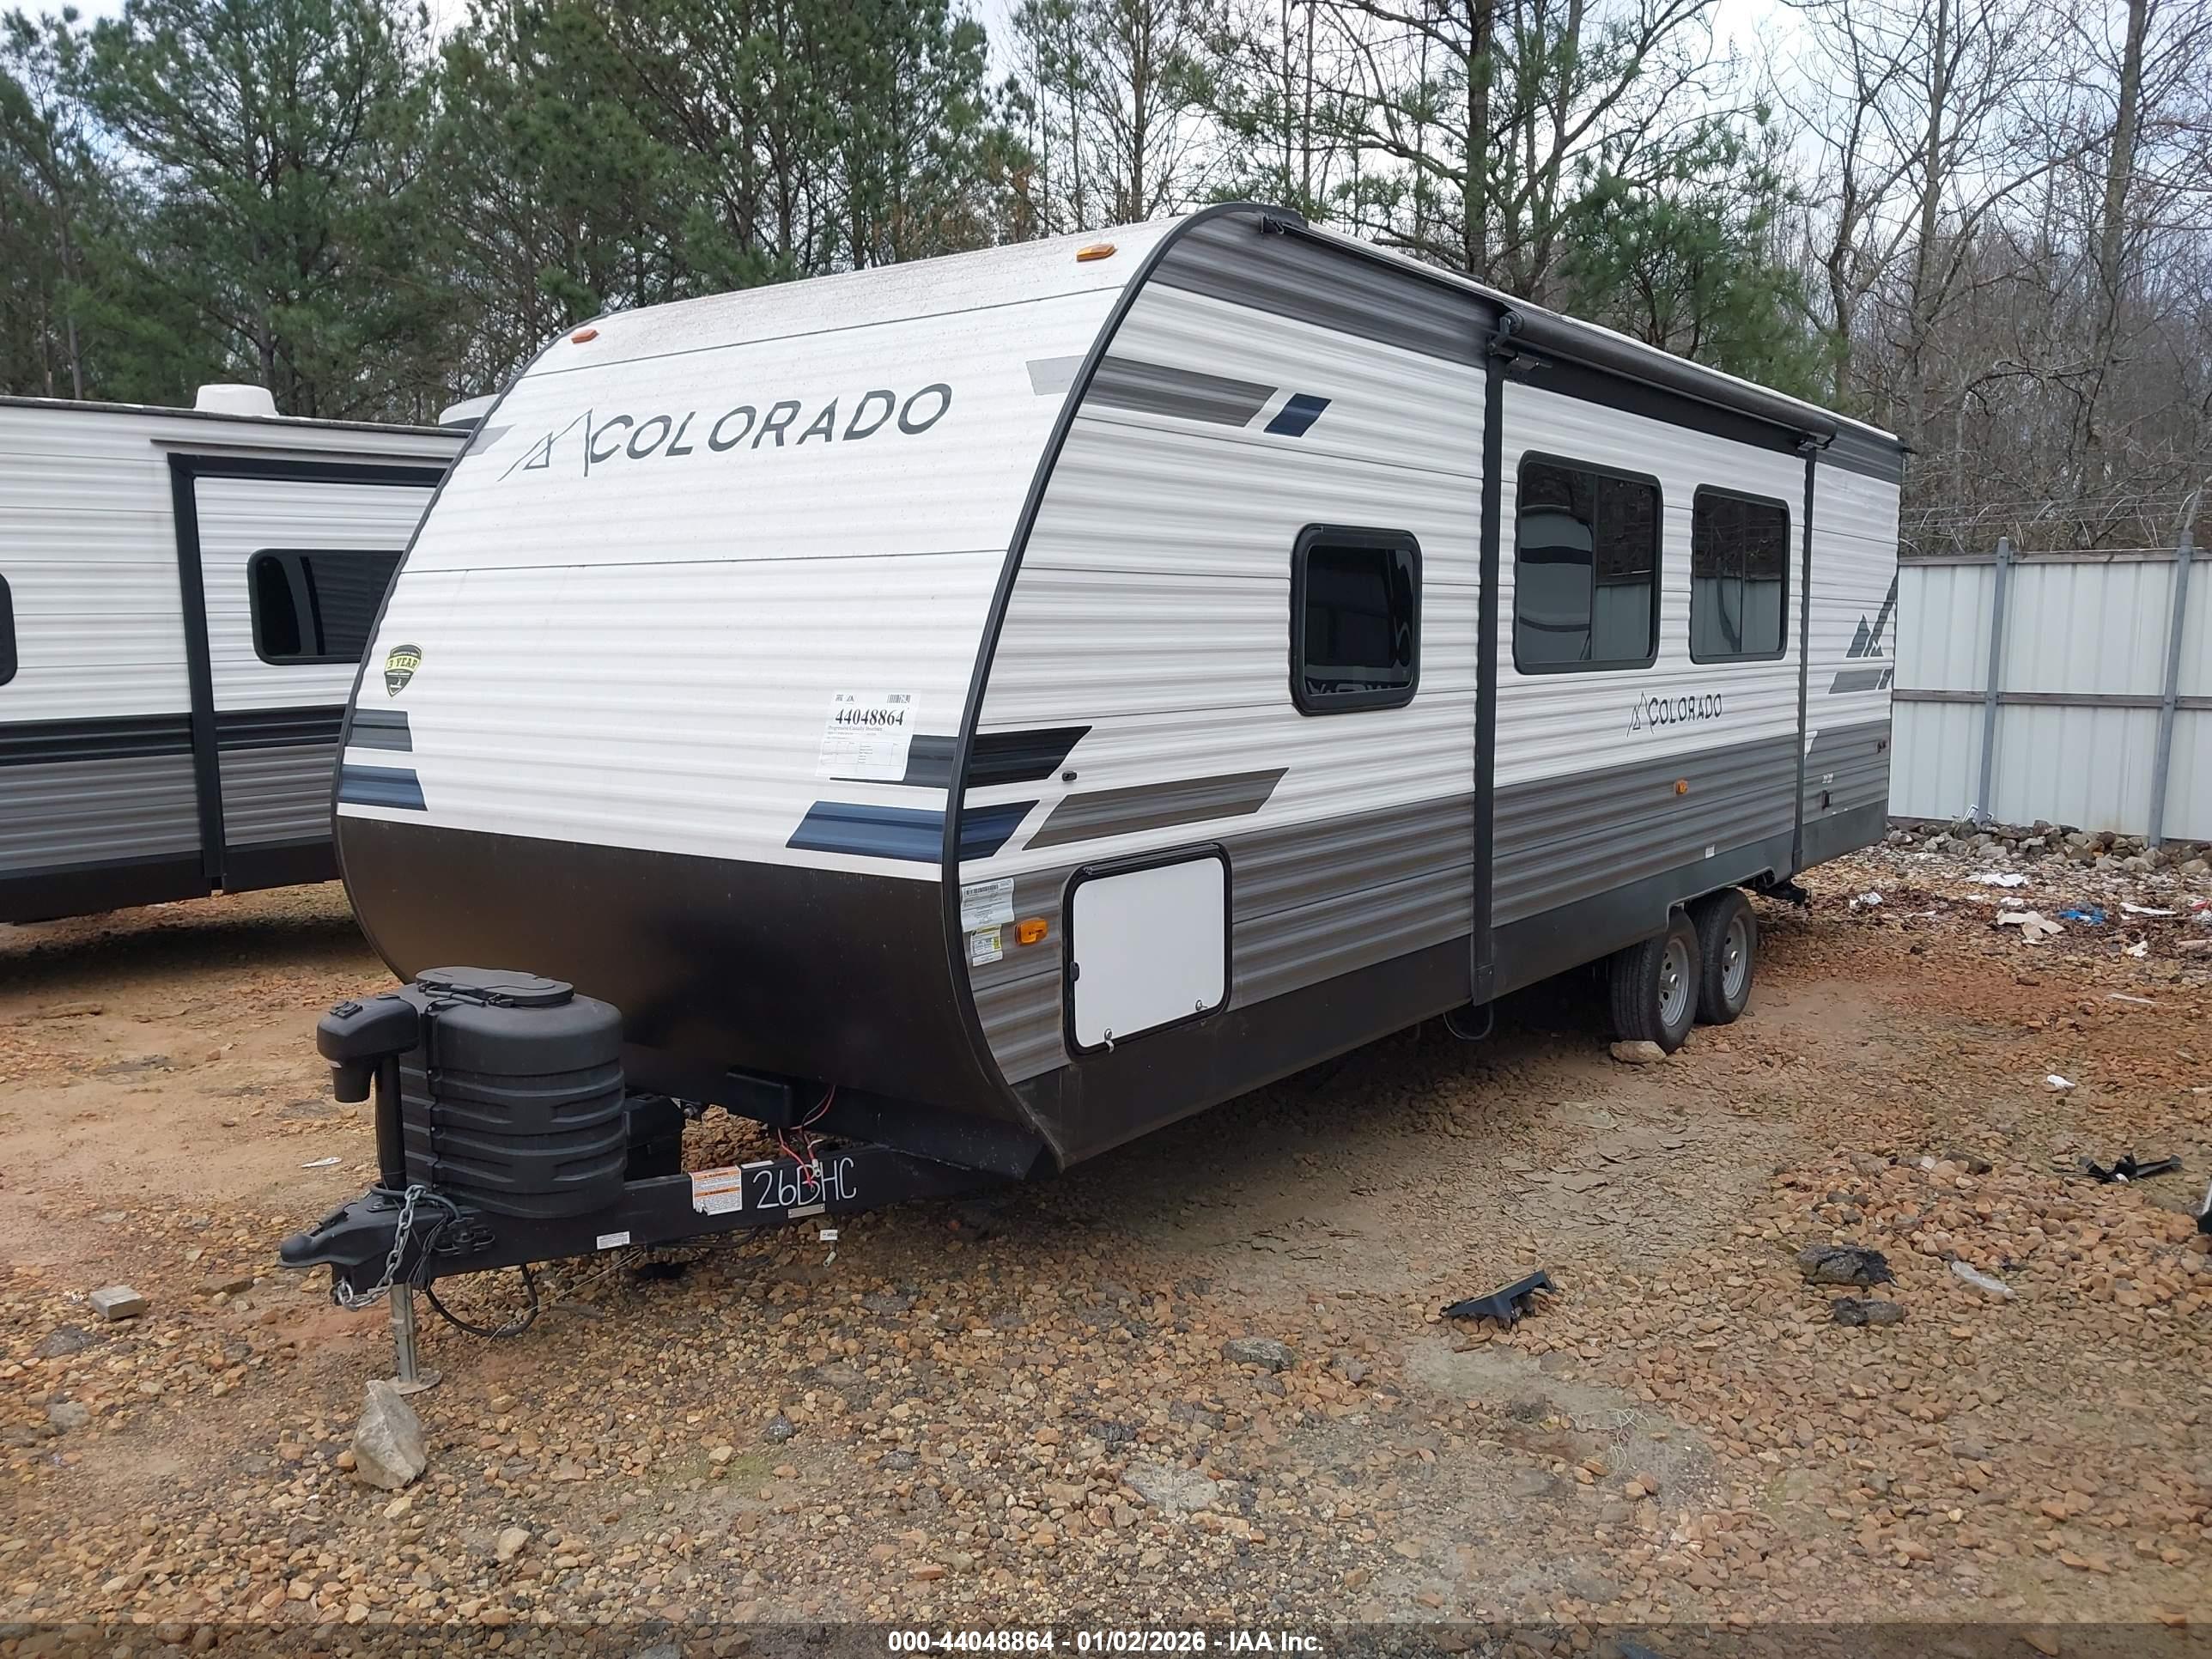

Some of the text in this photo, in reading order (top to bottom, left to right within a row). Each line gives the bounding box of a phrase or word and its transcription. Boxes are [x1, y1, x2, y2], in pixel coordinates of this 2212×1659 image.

[591, 383, 952, 464] COLORADO
[387, 657, 418, 669] 3 YEAR
[835, 708, 905, 726] 44048864
[1648, 693, 1723, 726] COLORADO
[752, 1158, 857, 1208] 26BHC
